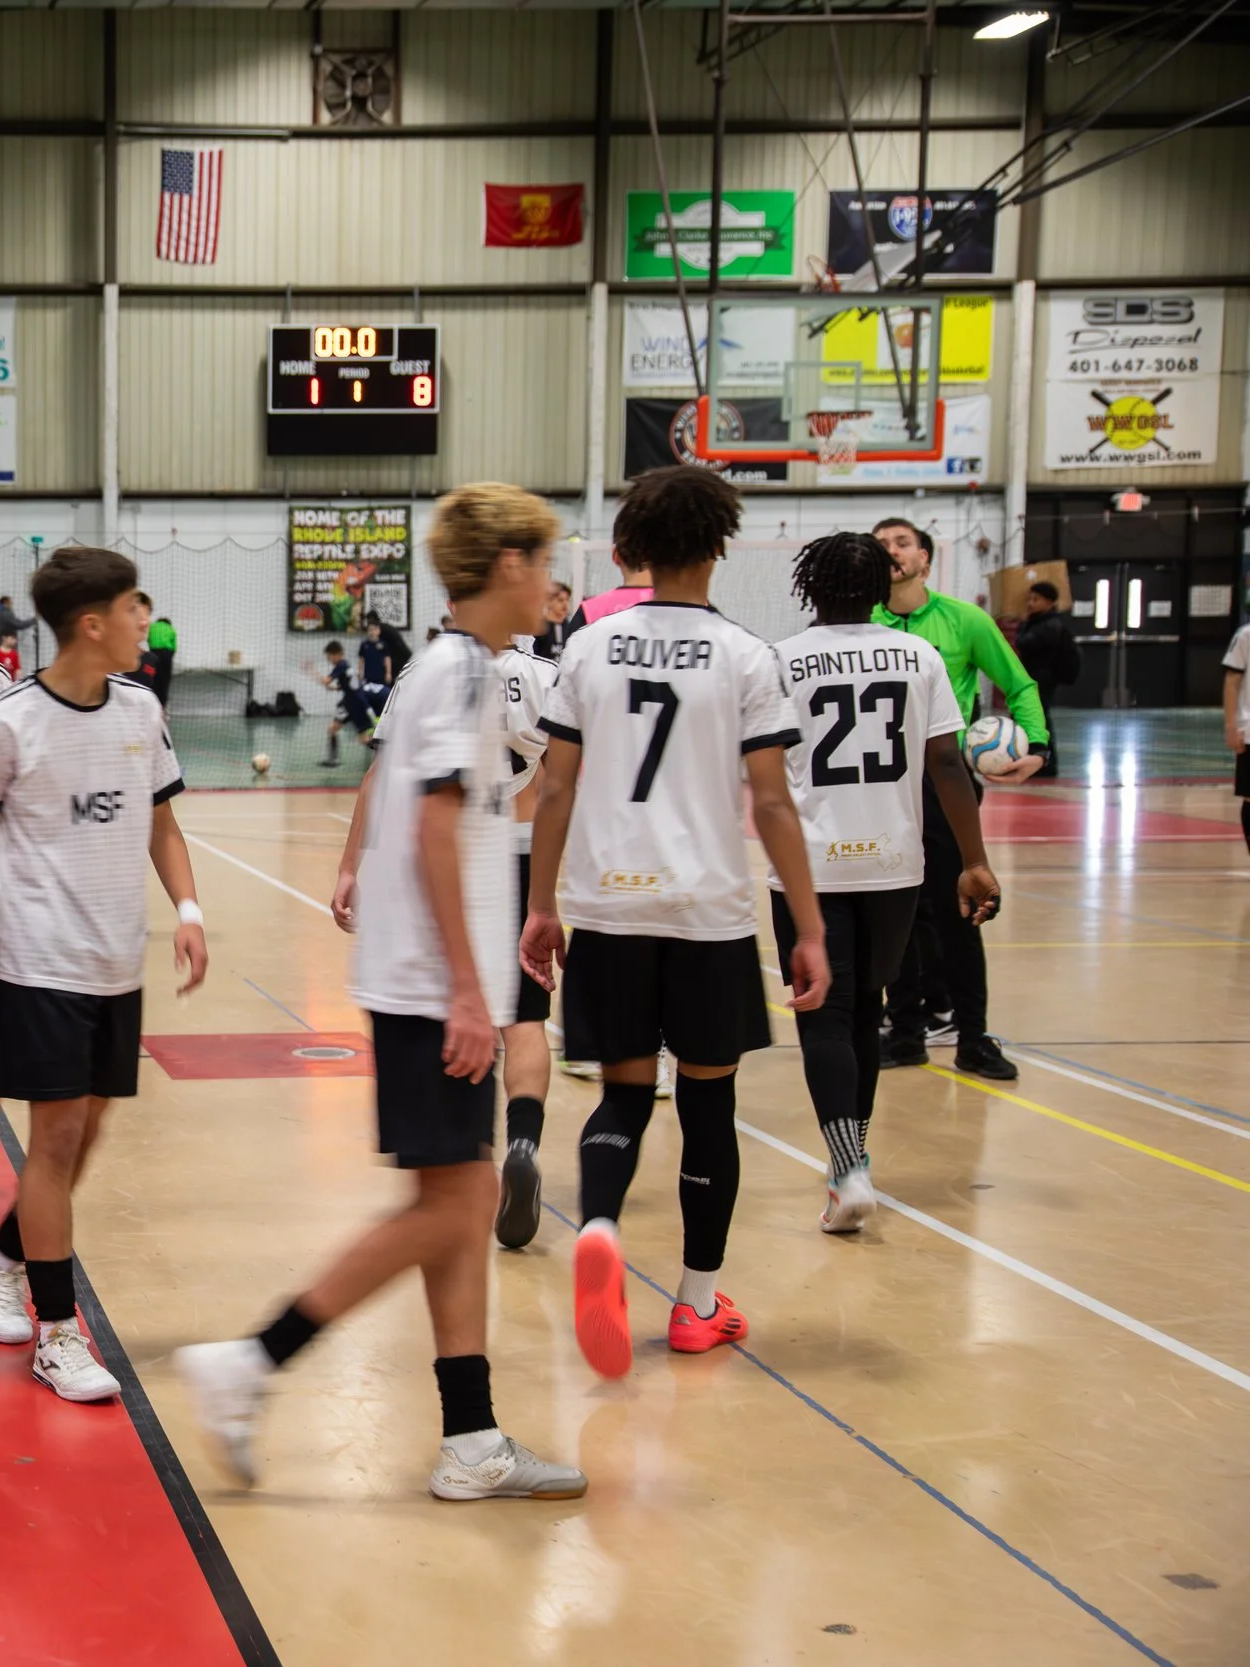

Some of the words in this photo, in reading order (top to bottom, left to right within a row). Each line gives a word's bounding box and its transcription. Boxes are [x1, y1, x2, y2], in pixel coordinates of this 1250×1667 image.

[315, 327, 376, 358] 00.0
[1065, 327, 1203, 349] Disposal
[279, 361, 317, 375] HOME
[390, 361, 431, 375] GUEST
[338, 367, 370, 379] PERIOD
[1069, 358, 1200, 372] 401-647-3068
[311, 378, 319, 405] 1
[353, 380, 362, 402] 1
[413, 376, 432, 406] 8
[1060, 450, 1202, 464] www.wwgsl.com
[293, 510, 341, 526] HOME
[347, 510, 370, 526] OF
[374, 509, 406, 525] THE
[348, 527, 407, 542] ISLAND
[360, 543, 406, 559] EXPO
[608, 634, 712, 669] GOUVEIA
[790, 648, 919, 682] SAINTLOTH
[627, 678, 681, 802] 7
[809, 681, 908, 787] 23
[71, 790, 126, 825] MSF
